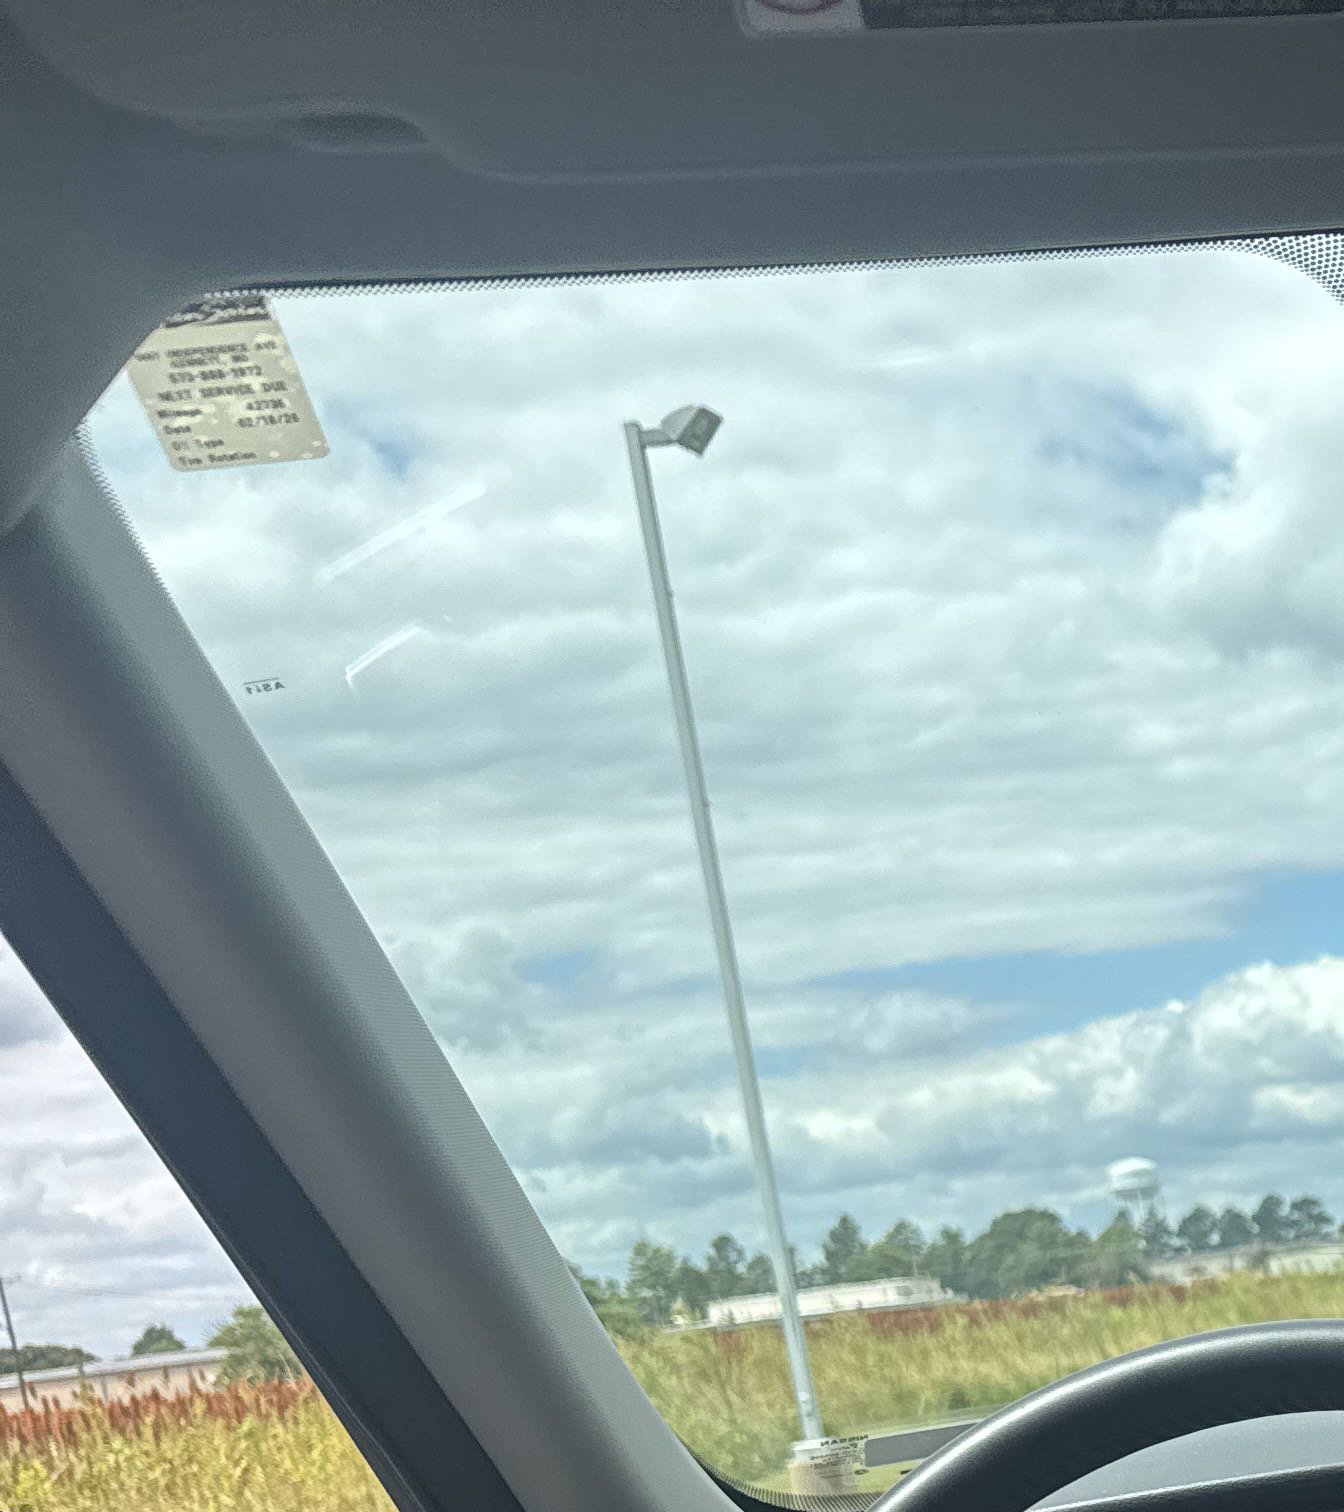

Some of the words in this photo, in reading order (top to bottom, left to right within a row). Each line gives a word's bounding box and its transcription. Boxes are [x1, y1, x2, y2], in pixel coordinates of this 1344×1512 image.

[157, 389, 192, 402] NEXT
[200, 384, 254, 398] SERVICE
[261, 381, 289, 393] DUE
